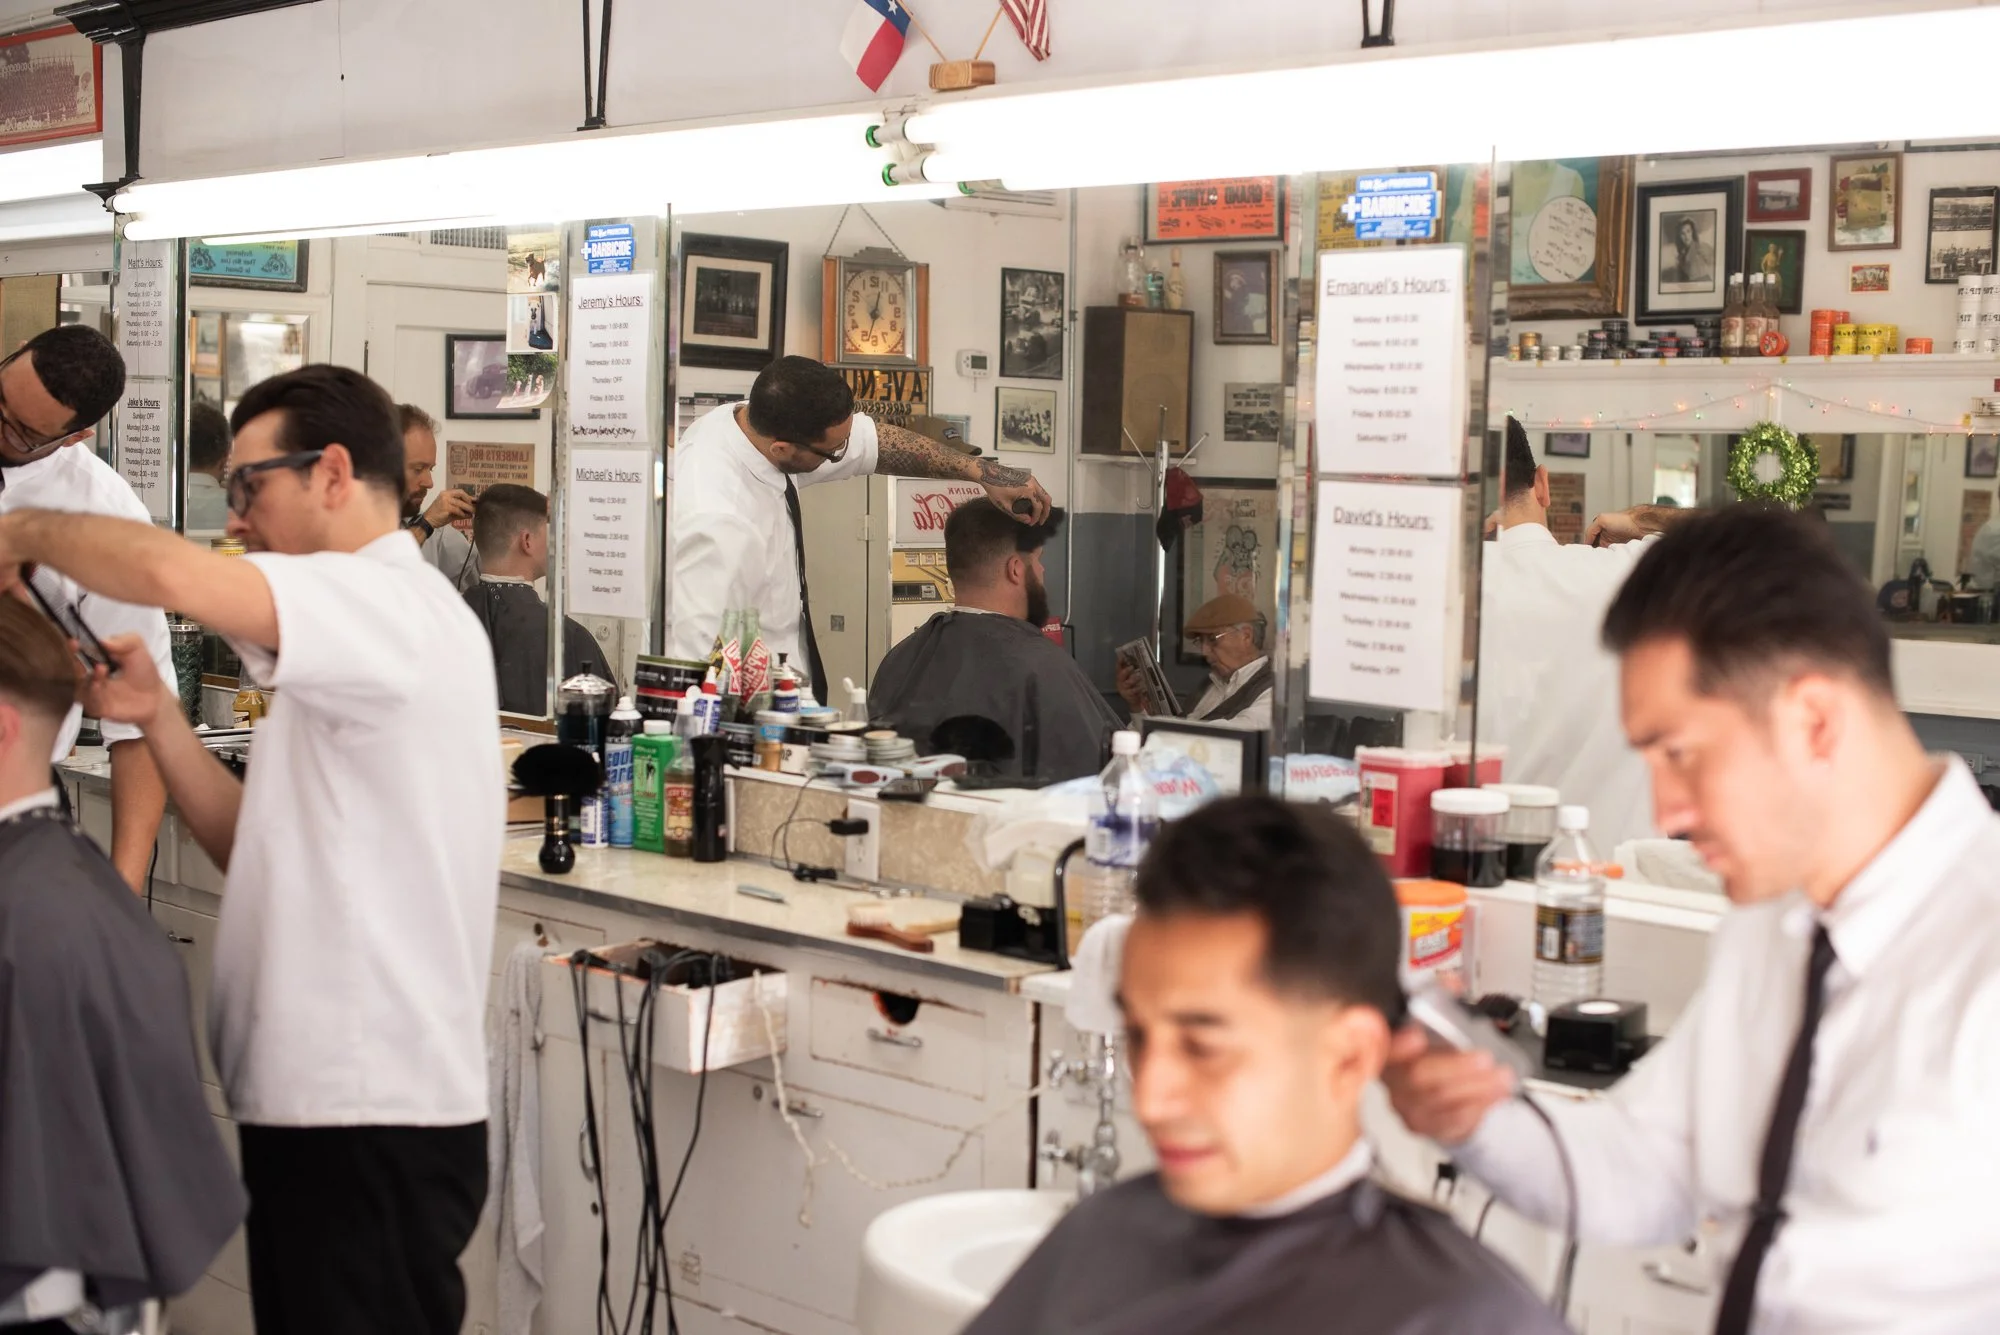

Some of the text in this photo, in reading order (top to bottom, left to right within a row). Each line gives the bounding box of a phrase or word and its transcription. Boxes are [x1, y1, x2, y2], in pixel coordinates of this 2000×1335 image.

[1361, 194, 1433, 218] BARBICIDE
[592, 240, 632, 258] BARBICIDE
[1327, 276, 1451, 296] Emanuel's Hours:
[578, 294, 643, 309] Jeremy's Hours:
[128, 398, 160, 409] Jake's Hours:
[576, 468, 641, 483] Michael's Hours:
[1333, 506, 1434, 530] David's Hours:
